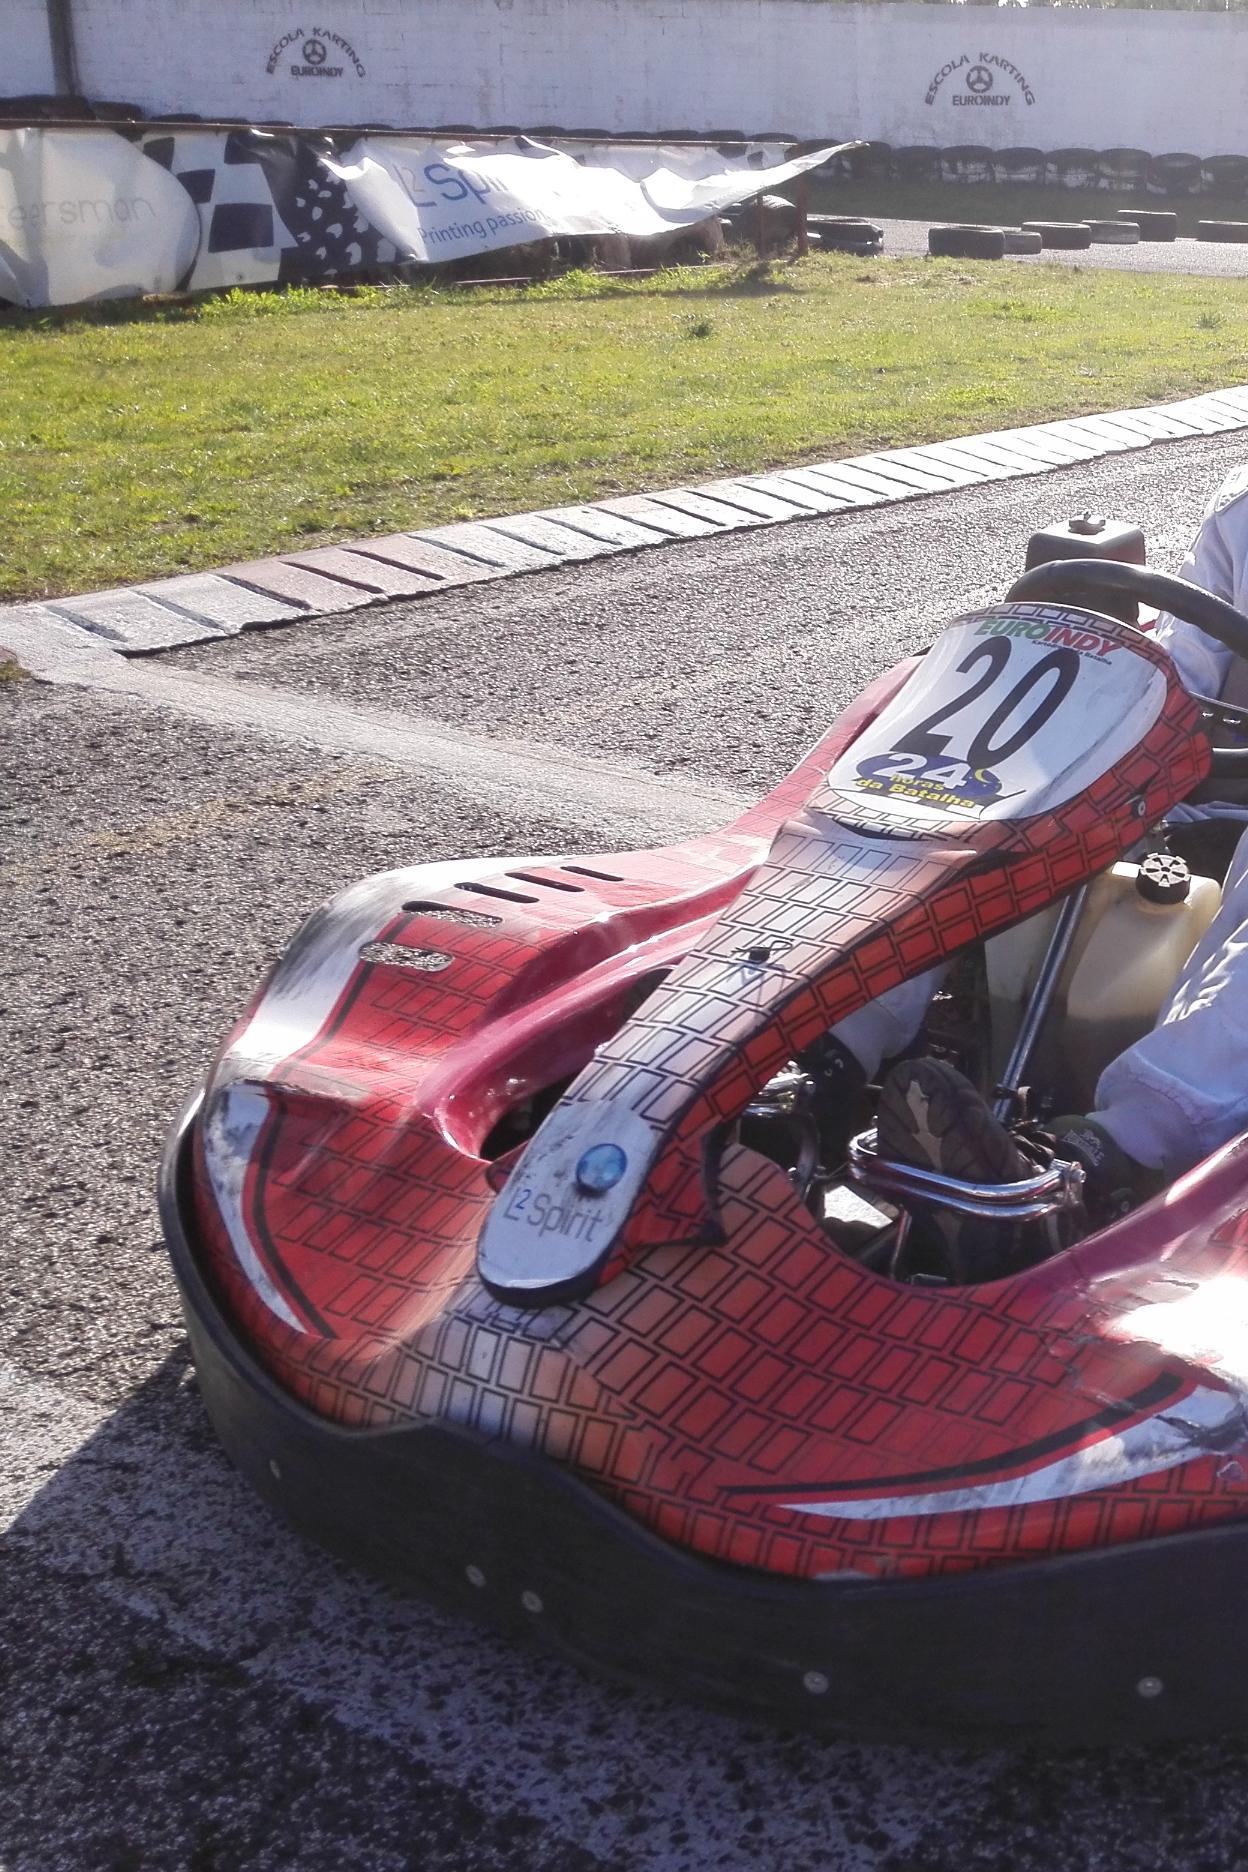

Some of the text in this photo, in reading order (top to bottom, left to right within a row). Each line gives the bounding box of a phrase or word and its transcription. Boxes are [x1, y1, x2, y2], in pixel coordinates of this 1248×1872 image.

[265, 26, 366, 78] ESCOLA KARTING
[924, 51, 1037, 106] ESCOLA KARTING
[951, 95, 1011, 107] EUROINDY
[973, 617, 1122, 657] EUROINDY
[889, 634, 1081, 770] 20
[872, 752, 972, 790] 24
[855, 778, 977, 810] da Batalha
